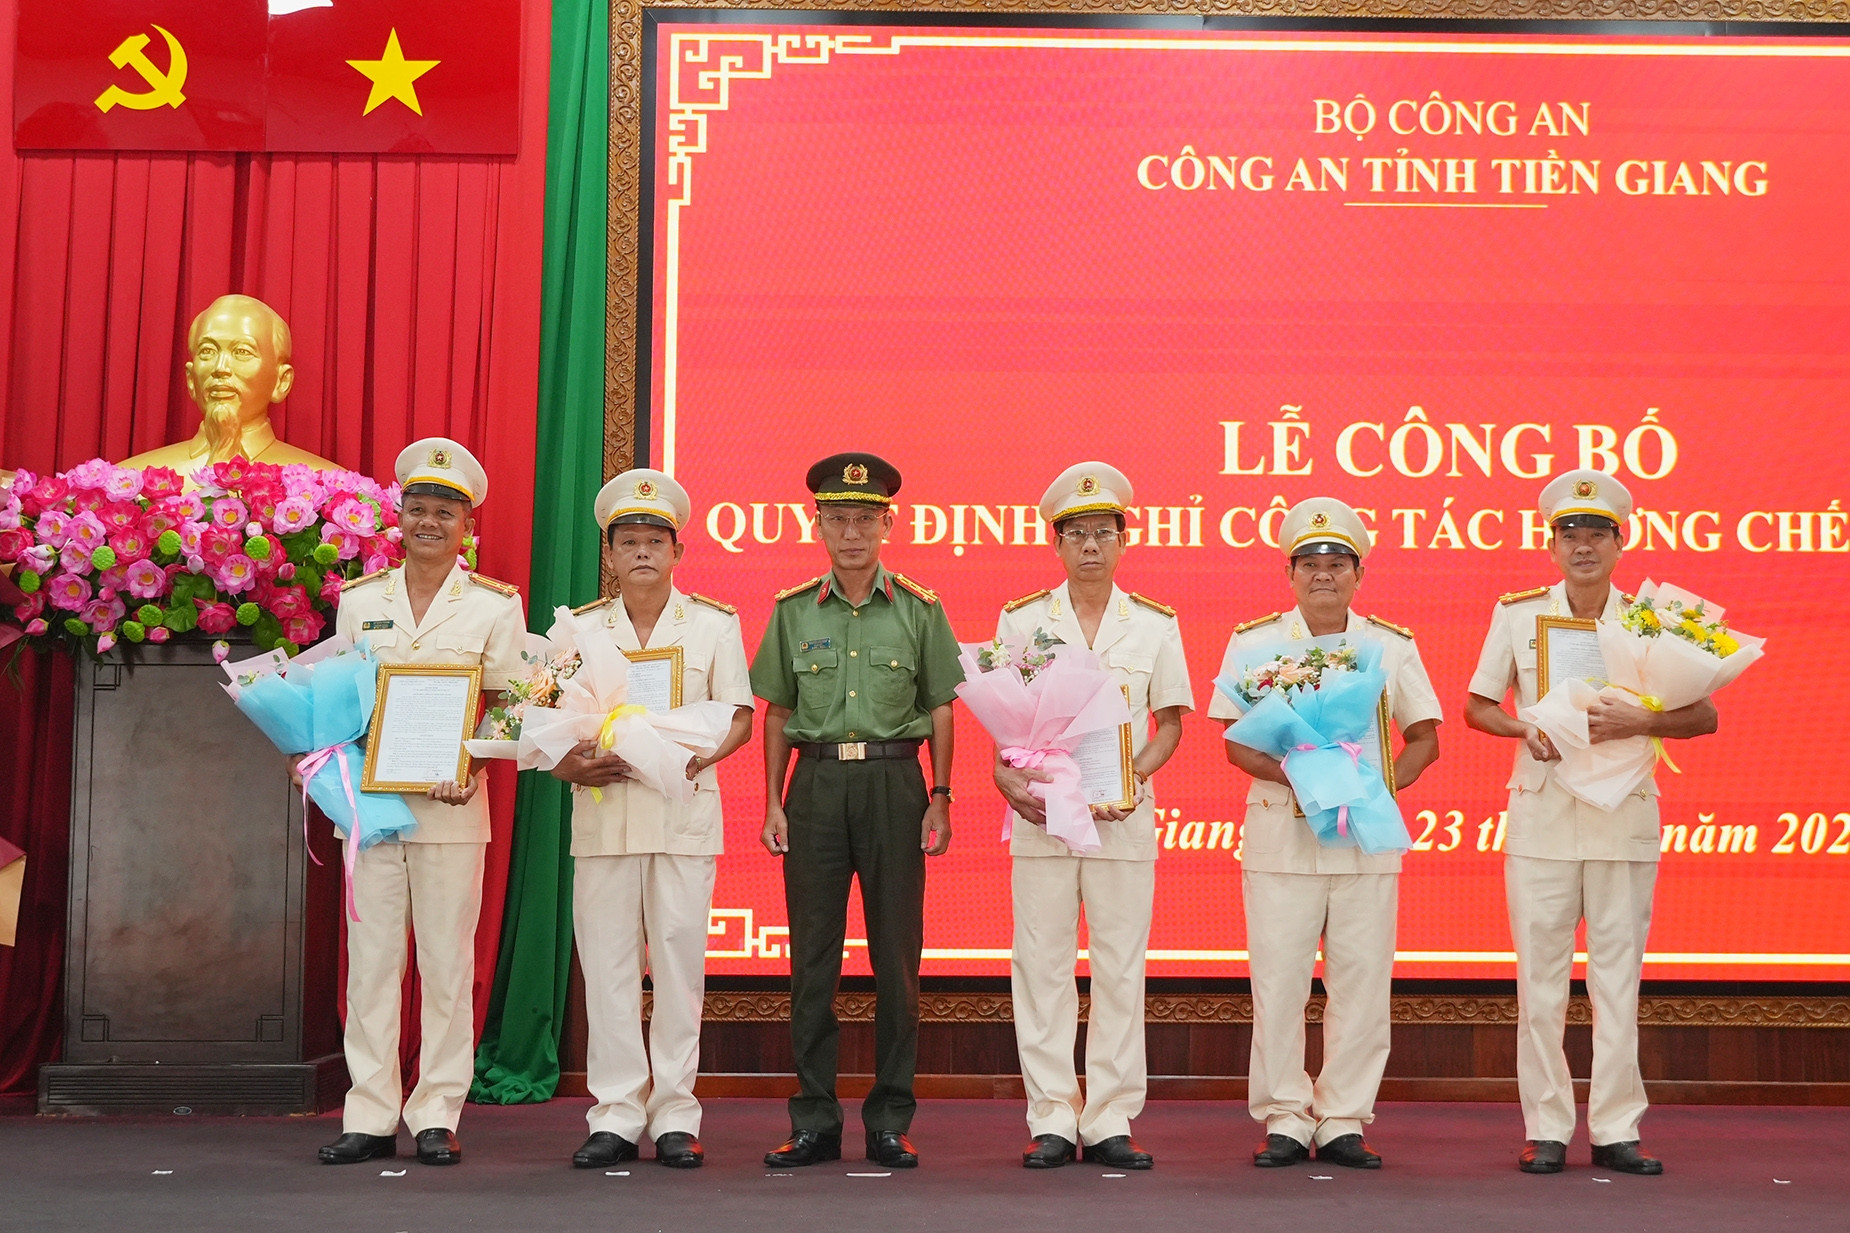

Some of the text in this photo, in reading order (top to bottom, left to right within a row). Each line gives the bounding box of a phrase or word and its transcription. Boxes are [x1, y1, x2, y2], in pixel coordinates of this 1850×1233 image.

[1313, 91, 1590, 141] BỘ CÔNG AN
[1136, 145, 1769, 196] CÔNG AN TỈNH TIỀN GIANG
[1218, 404, 1678, 480] LỄ CÔNG BỐ
[706, 496, 899, 553] QUY
[909, 503, 1049, 557] ĐỊNH
[1391, 496, 1504, 550] TÁC
[1736, 499, 1849, 553] CHẾ
[1410, 809, 1465, 852] 23
[1660, 812, 1758, 854] năm
